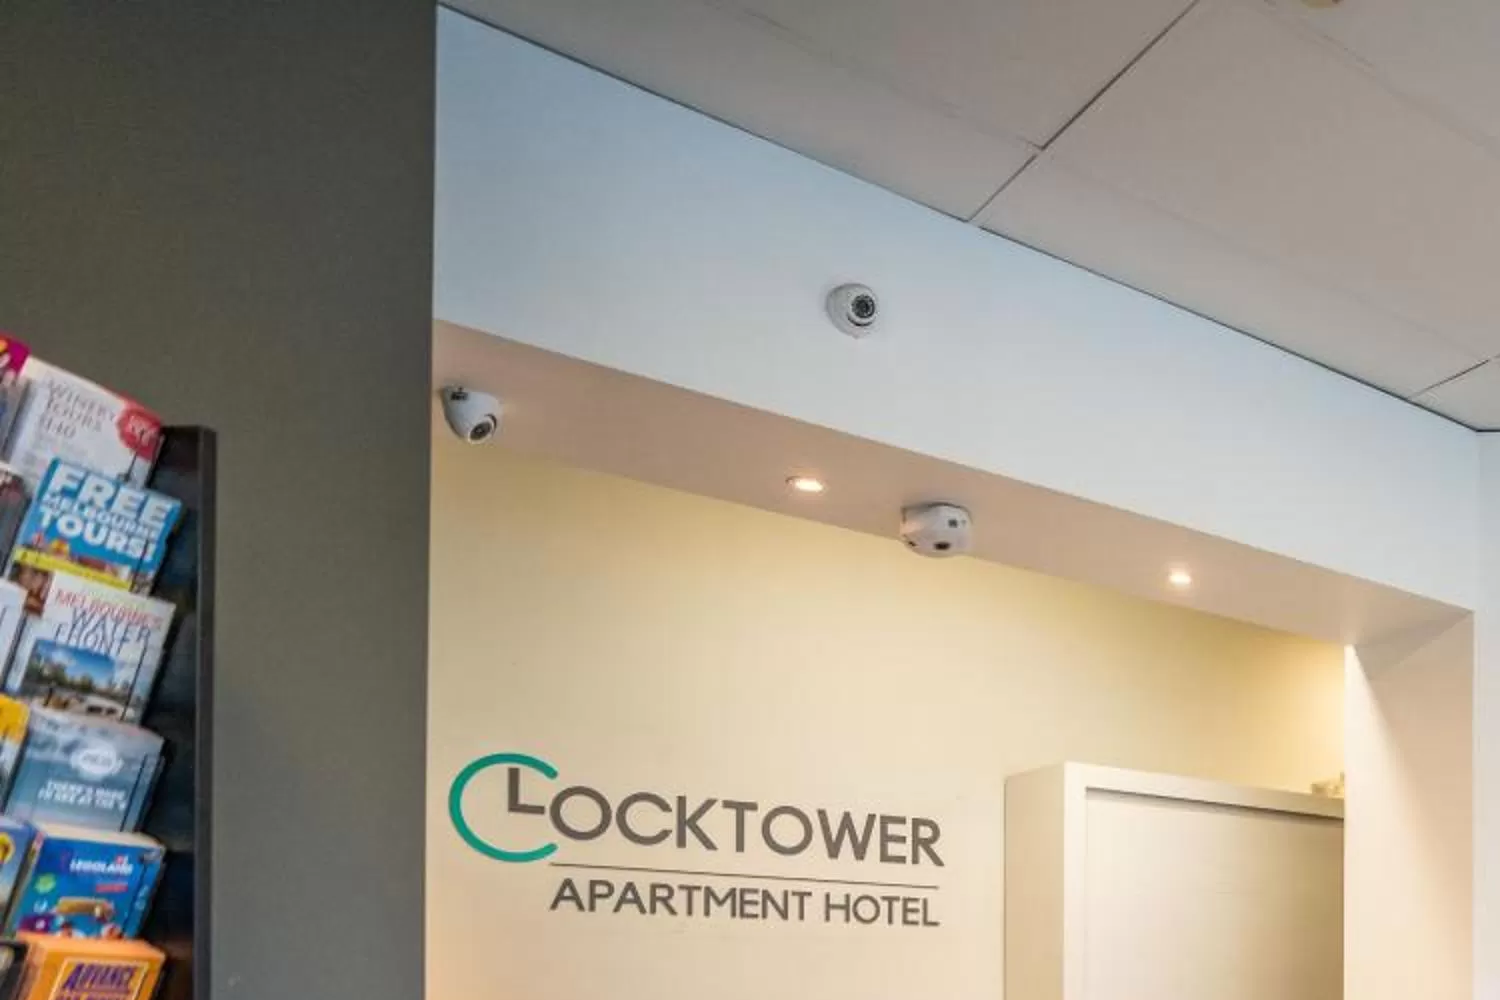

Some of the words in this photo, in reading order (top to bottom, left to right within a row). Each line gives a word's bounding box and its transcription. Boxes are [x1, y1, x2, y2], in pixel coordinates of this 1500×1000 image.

[46, 462, 172, 528] FREE
[448, 752, 945, 867] CLOCKTOWER
[549, 877, 812, 922] APARTMENT
[824, 892, 940, 927] HOTEL
